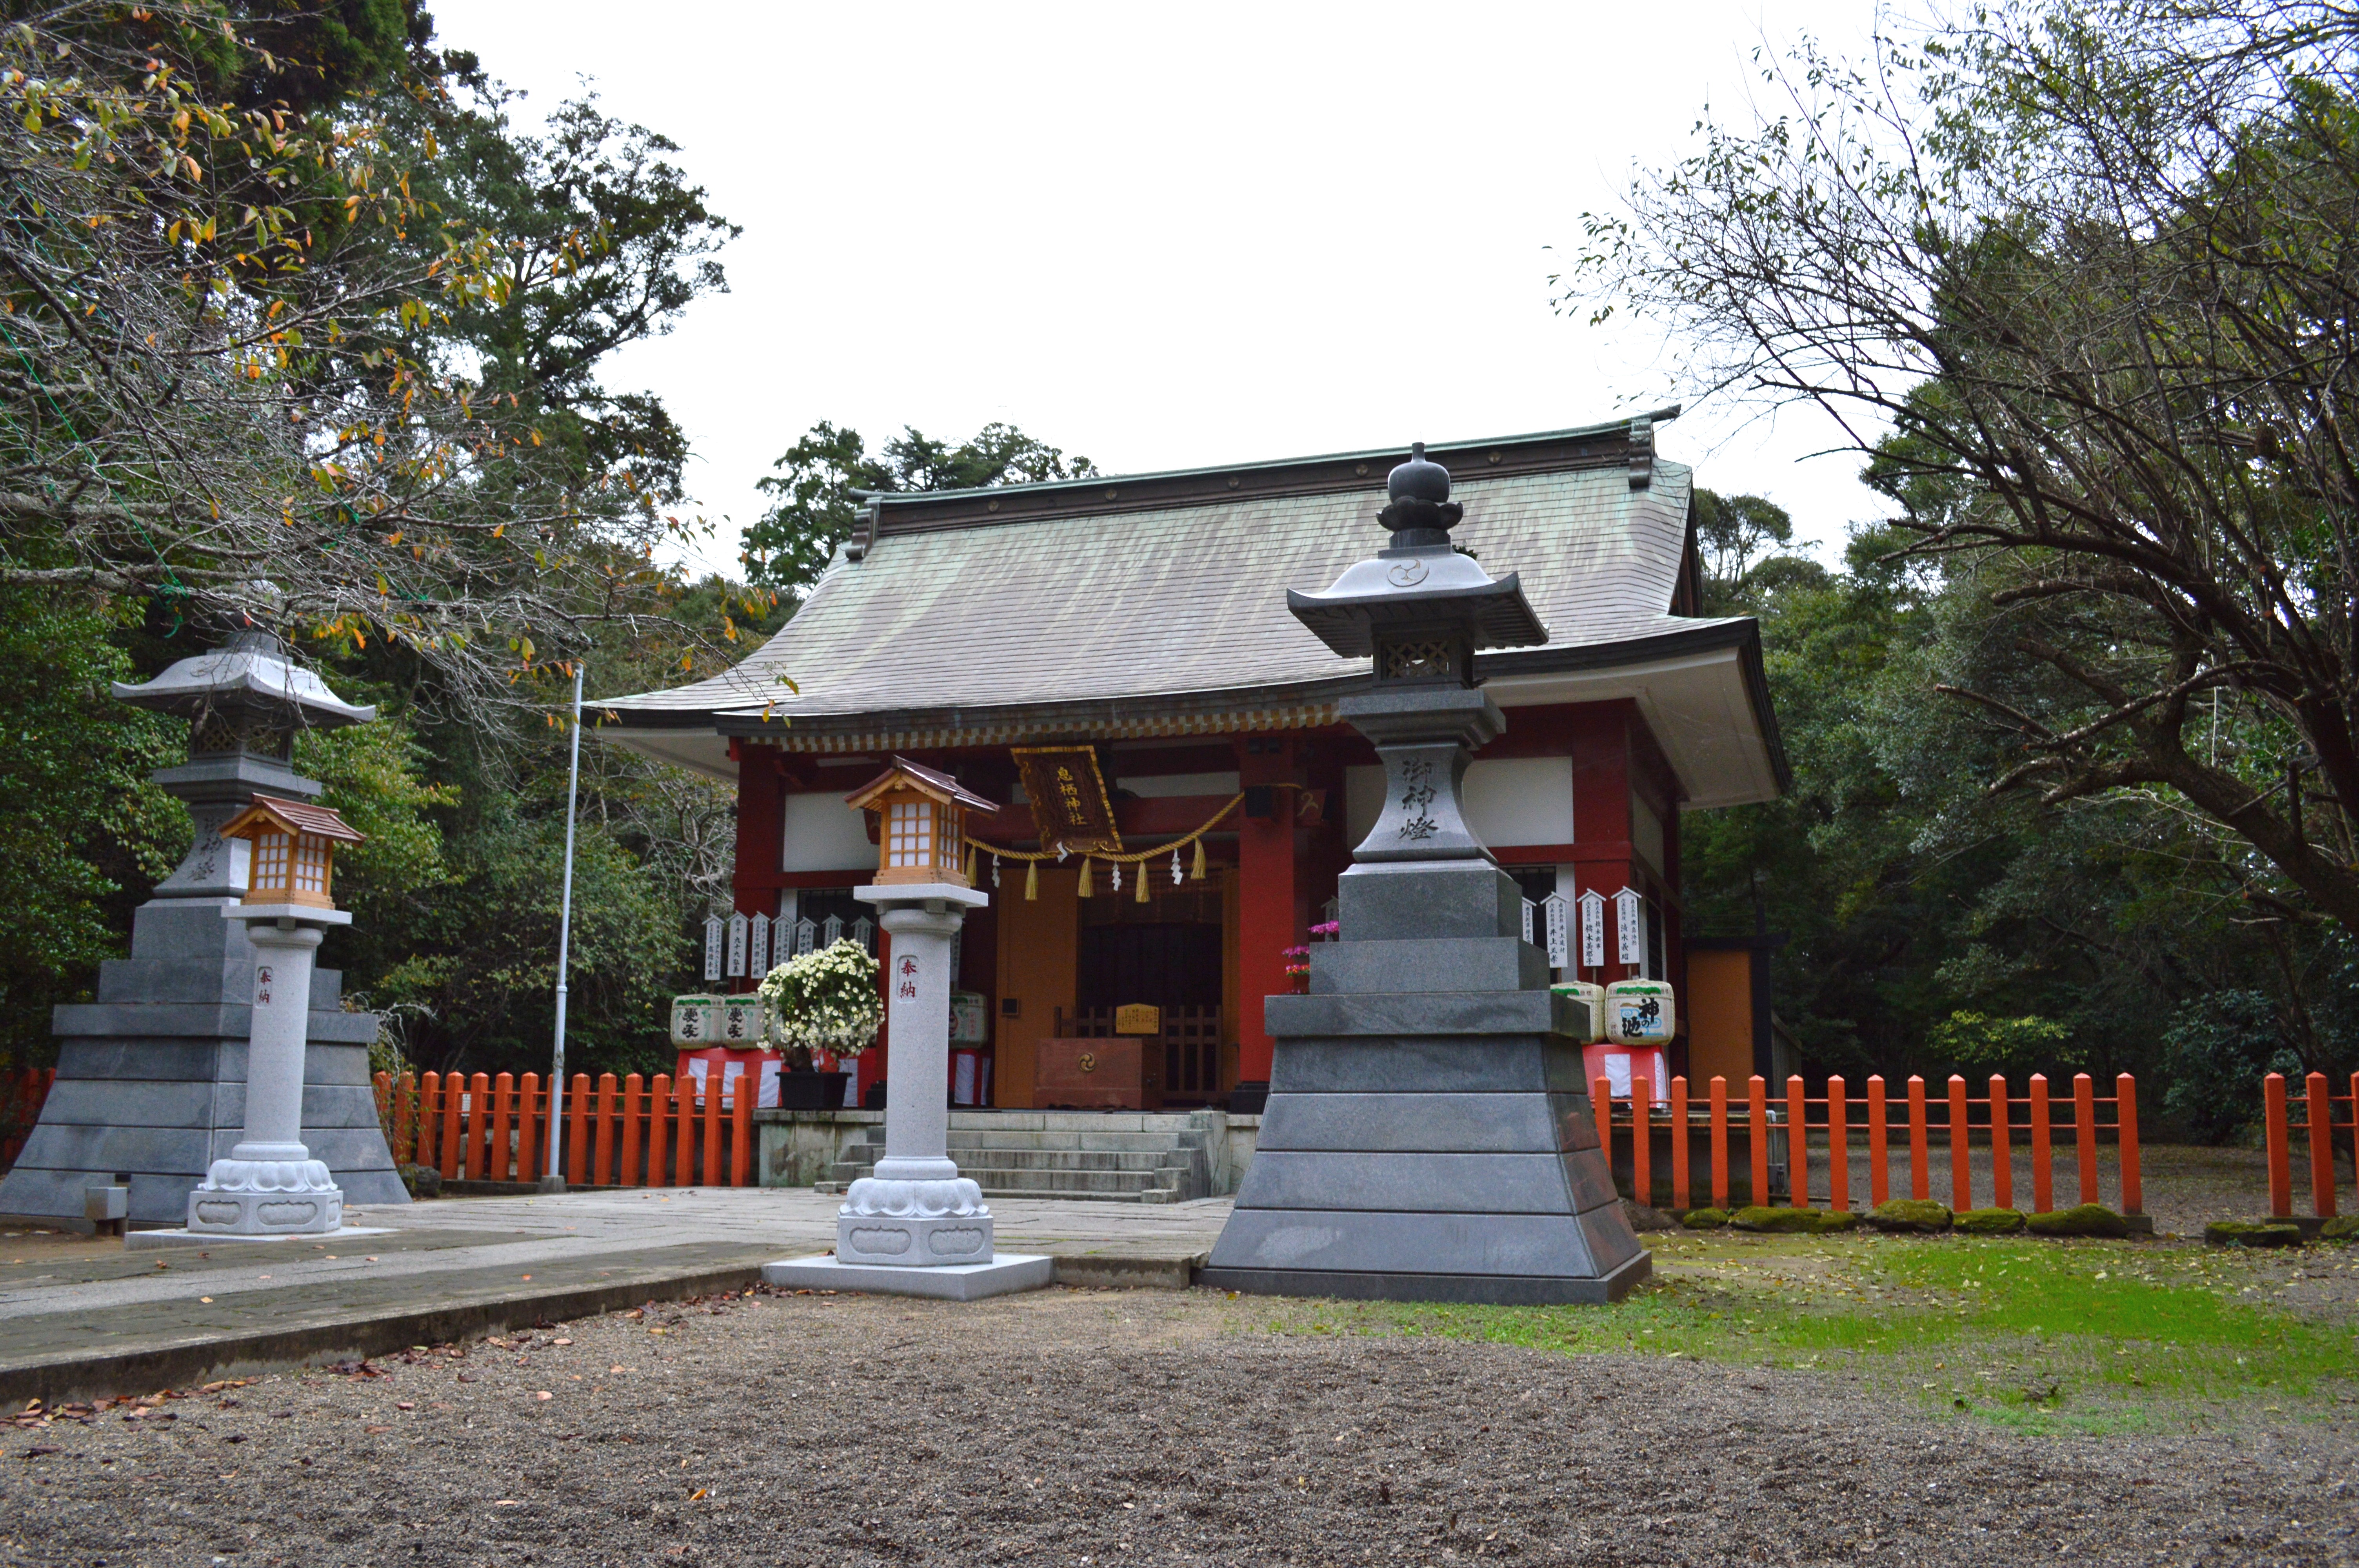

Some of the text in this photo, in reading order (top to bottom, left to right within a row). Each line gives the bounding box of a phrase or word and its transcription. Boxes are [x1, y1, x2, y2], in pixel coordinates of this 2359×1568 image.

[1057, 767, 1088, 826] 息栖神社
[1399, 757, 1439, 840] 御神燈
[258, 969, 271, 1004] 奉納
[900, 959, 916, 999] 奉納
[1622, 997, 1659, 1038] 神の池
